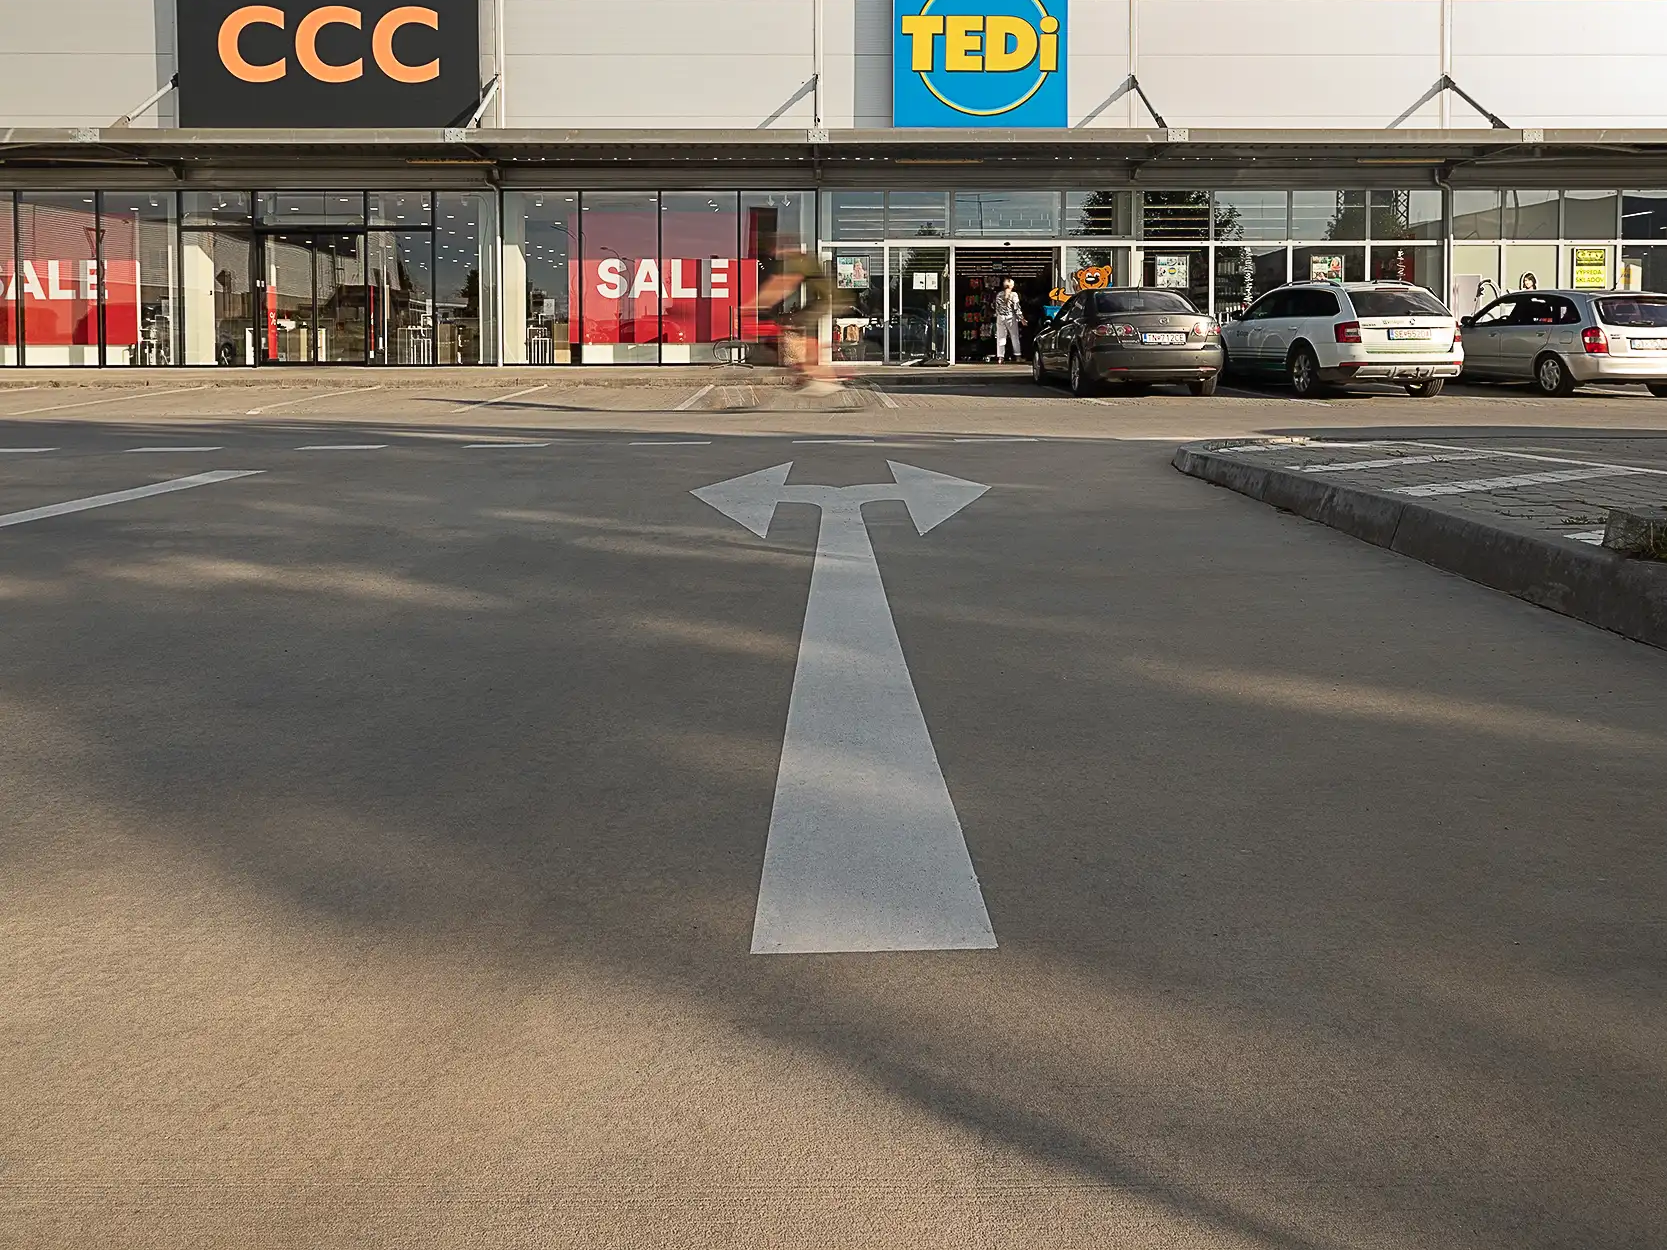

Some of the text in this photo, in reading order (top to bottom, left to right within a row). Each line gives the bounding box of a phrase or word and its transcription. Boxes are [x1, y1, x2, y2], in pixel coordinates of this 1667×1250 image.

[217, 5, 440, 83] CCC
[901, 15, 1060, 72] TEDi
[0, 260, 108, 300] ALE
[596, 258, 729, 299] SALE
